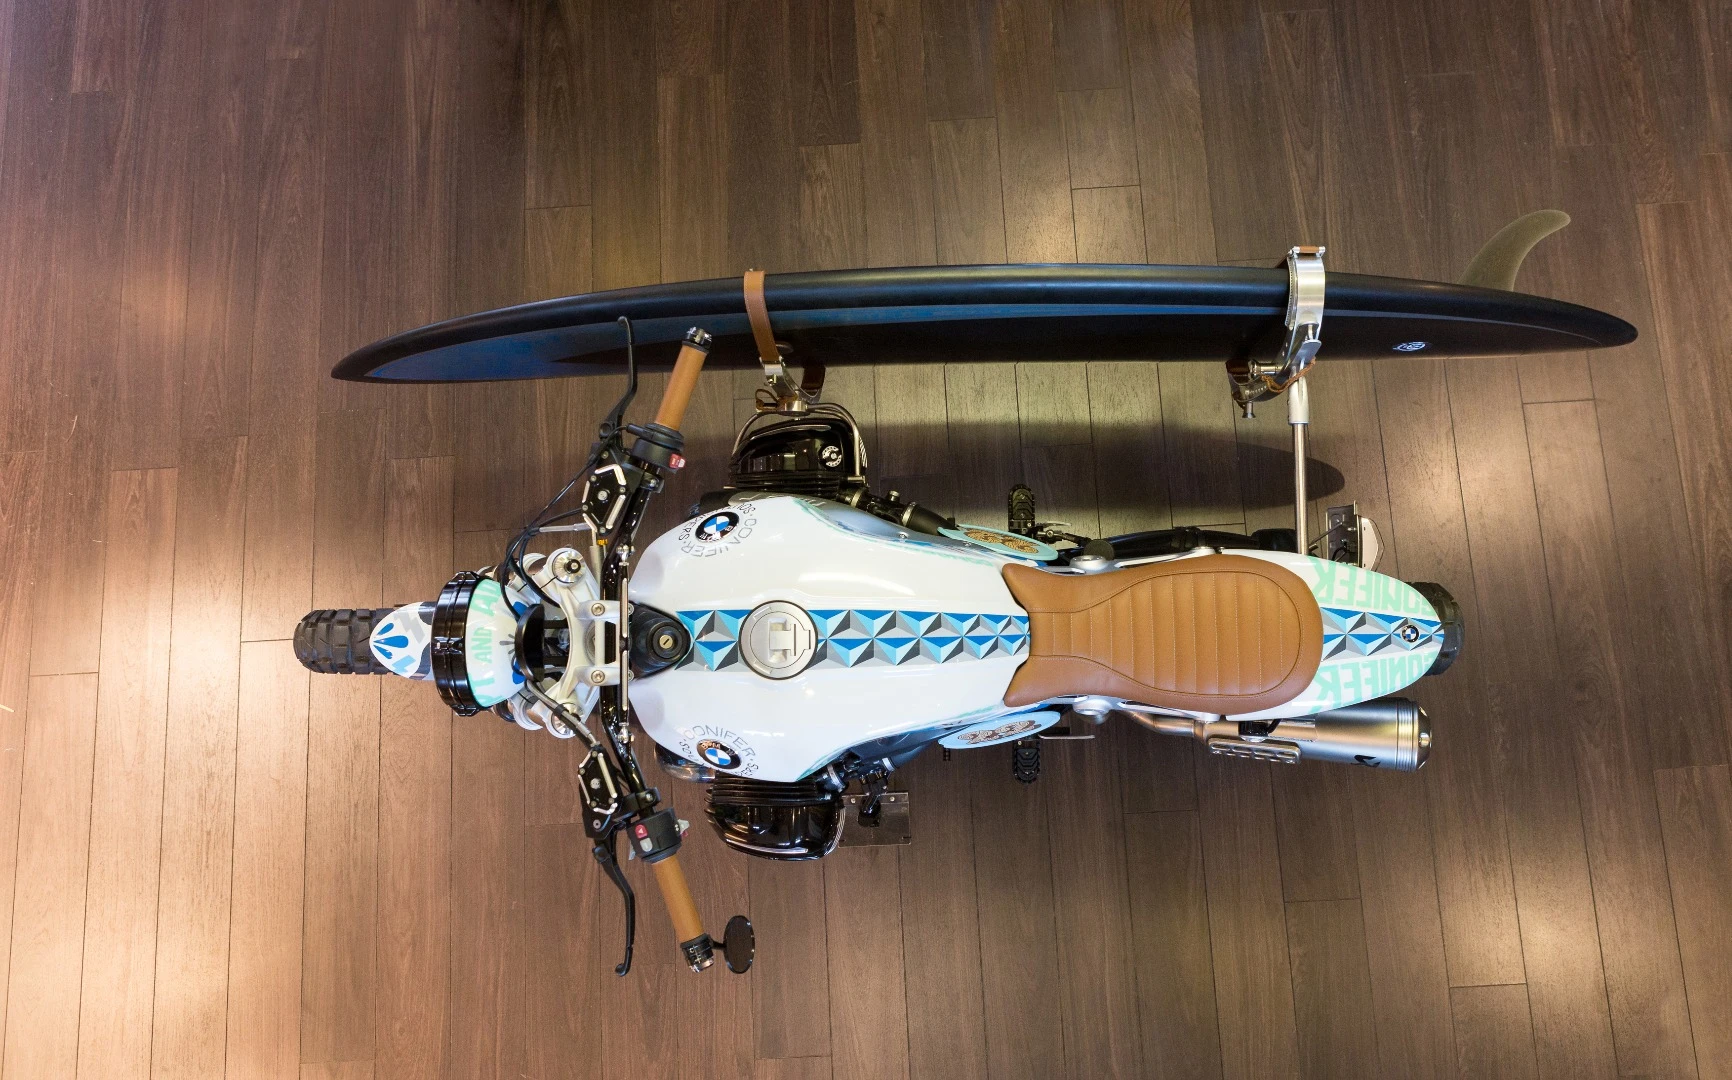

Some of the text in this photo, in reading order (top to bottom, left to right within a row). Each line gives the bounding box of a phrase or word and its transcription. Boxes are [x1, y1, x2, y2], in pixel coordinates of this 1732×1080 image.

[681, 518, 757, 558] CONIFER
[471, 627, 493, 664] AND
[683, 724, 756, 757] CONIFER
